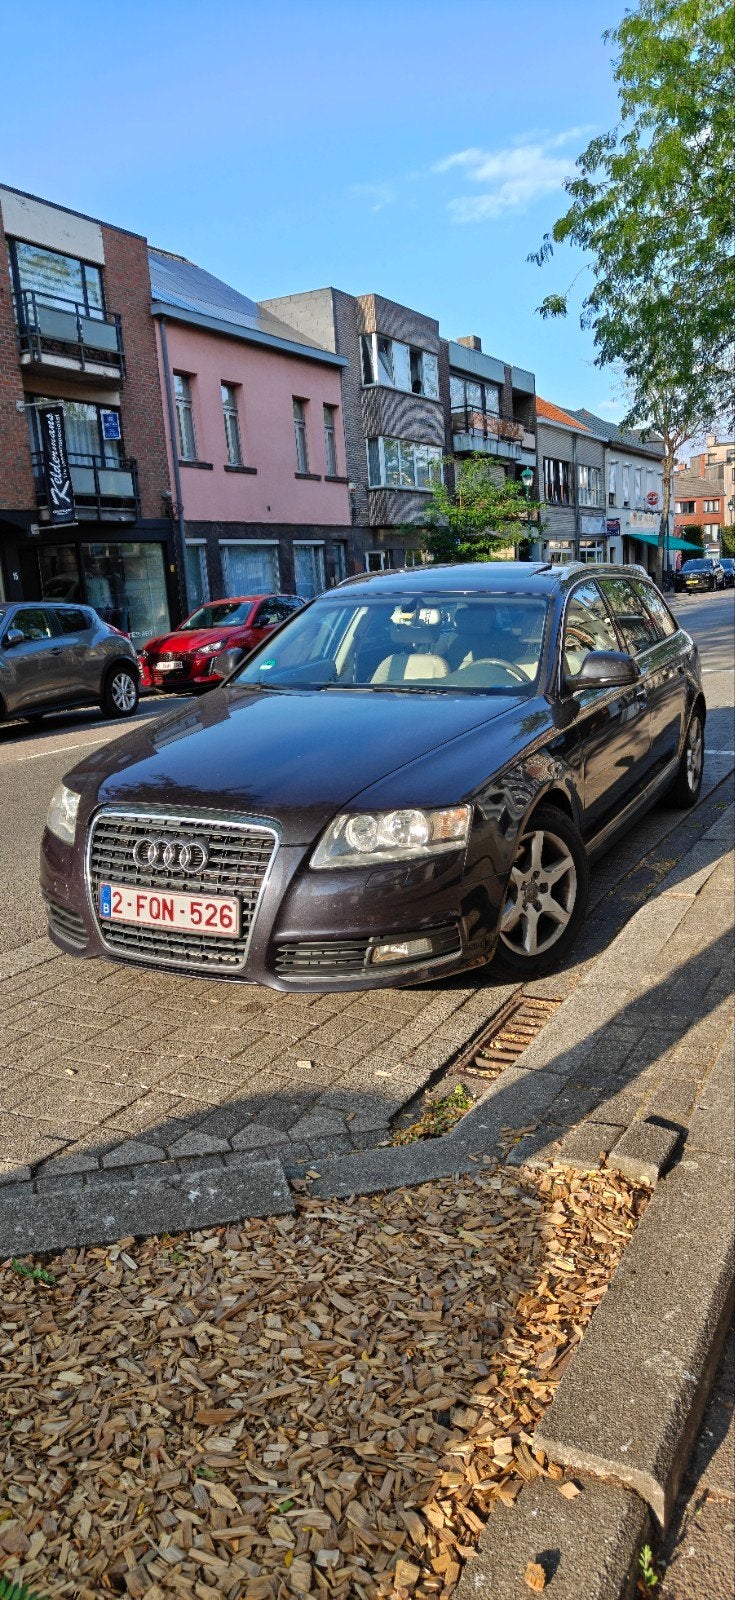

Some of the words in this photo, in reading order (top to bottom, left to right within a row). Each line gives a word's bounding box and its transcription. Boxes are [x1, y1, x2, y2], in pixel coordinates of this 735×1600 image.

[46, 412, 70, 505] Keldermans
[12, 571, 19, 581] 15
[103, 902, 109, 914] B
[112, 891, 233, 929] 2-FQN-526
